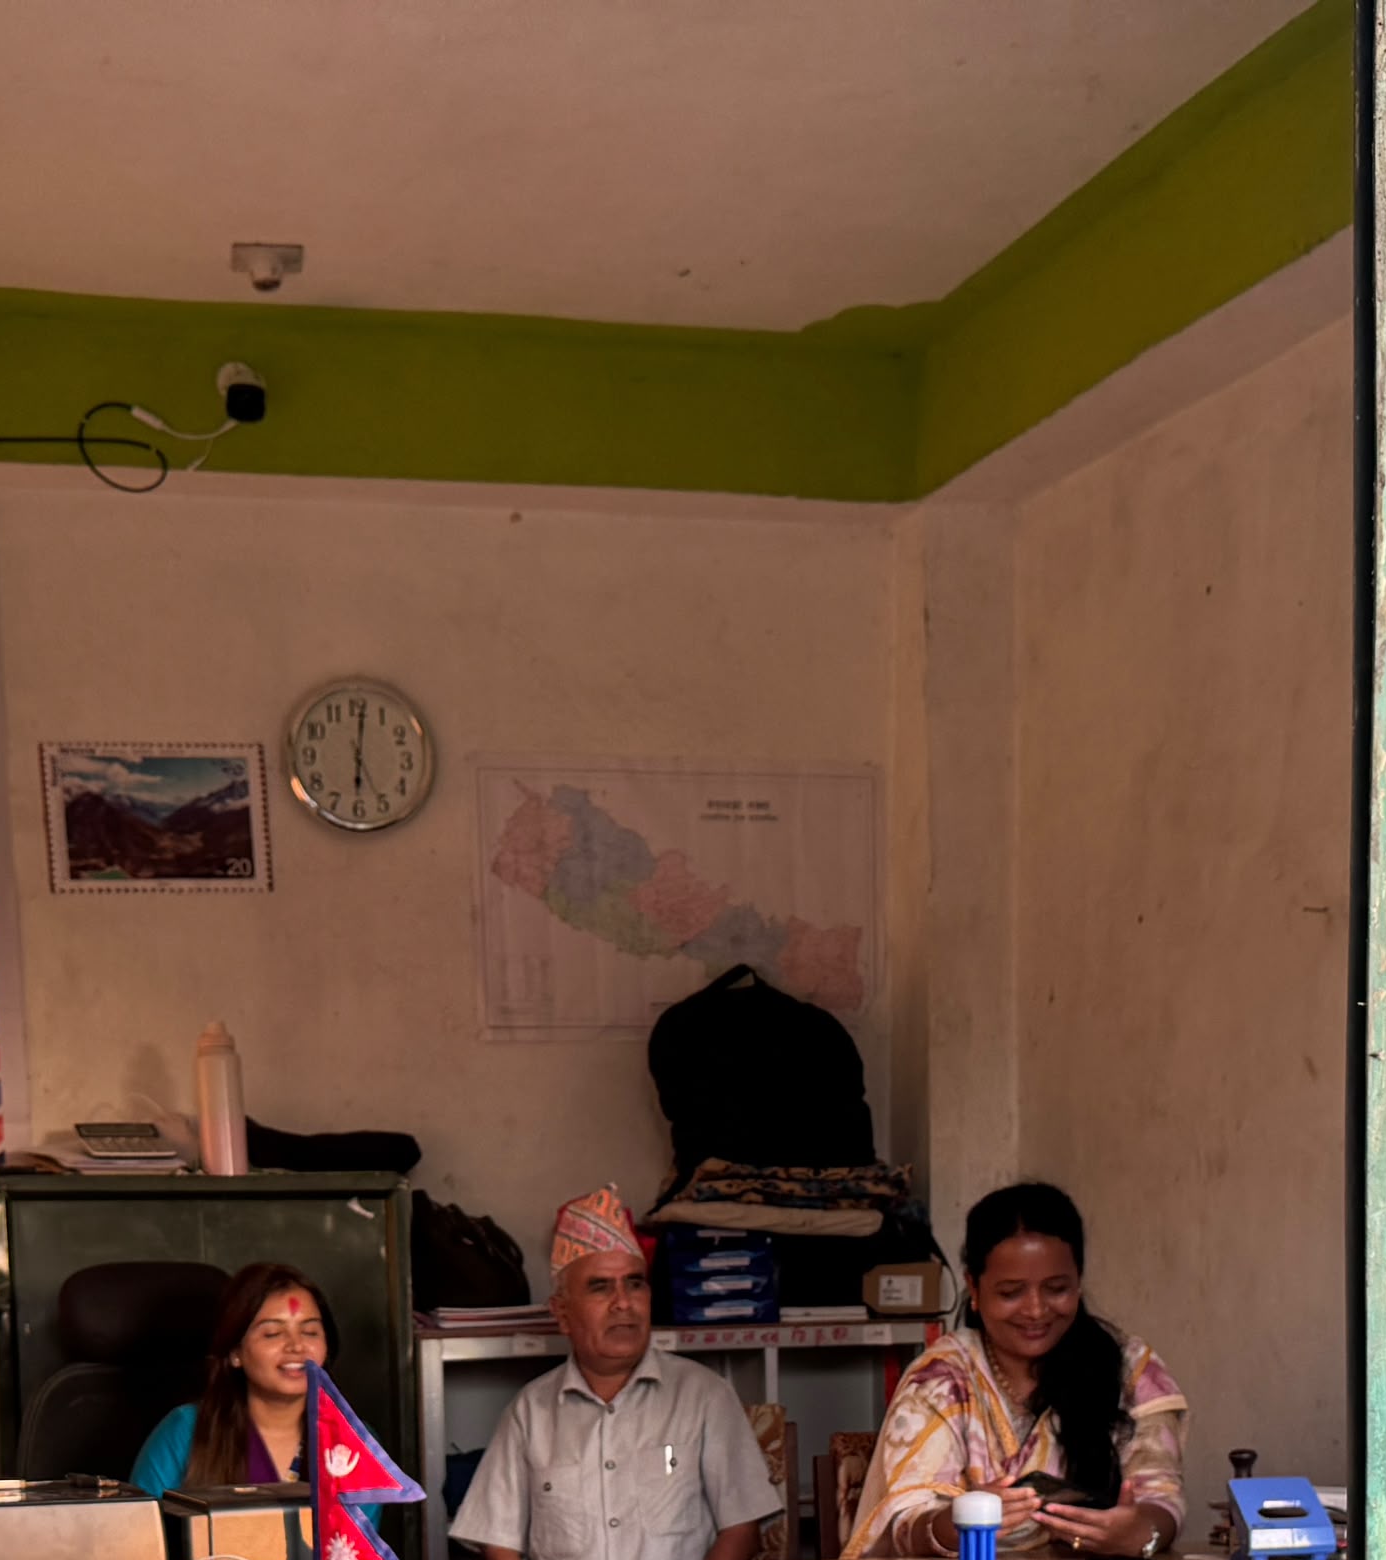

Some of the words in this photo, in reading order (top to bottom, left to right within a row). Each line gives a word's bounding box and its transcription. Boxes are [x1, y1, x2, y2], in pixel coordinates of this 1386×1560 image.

[307, 720, 326, 741] 10
[393, 724, 406, 746] 2
[301, 746, 317, 766] 9
[399, 751, 413, 771] 3
[328, 790, 342, 811] 7
[352, 800, 366, 818] 6
[376, 793, 390, 813] 5
